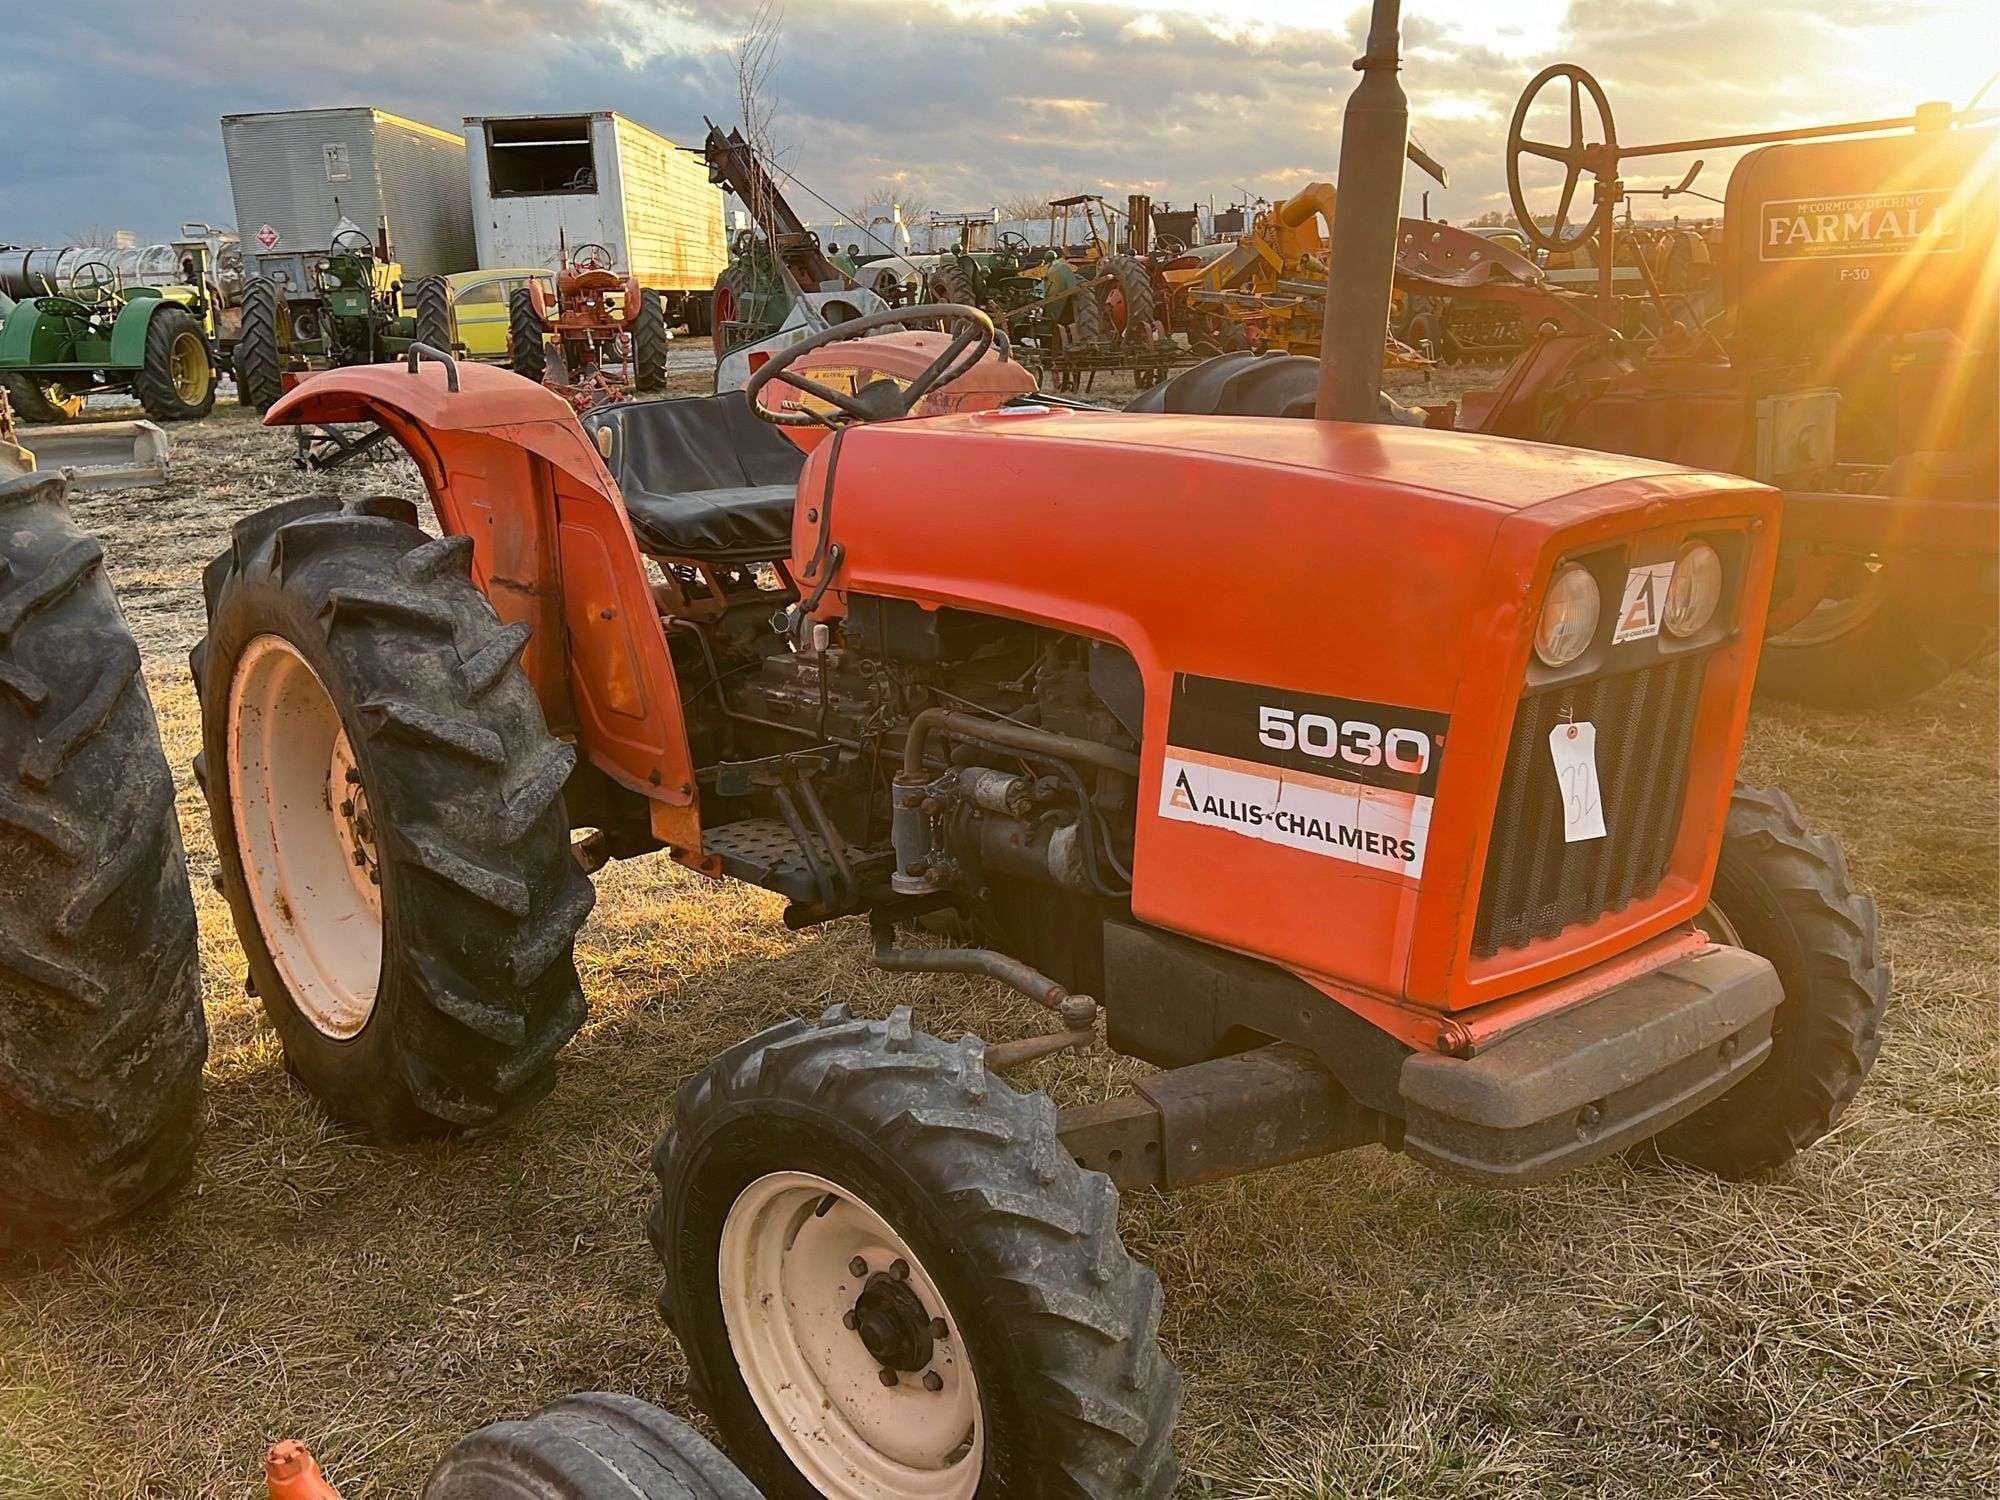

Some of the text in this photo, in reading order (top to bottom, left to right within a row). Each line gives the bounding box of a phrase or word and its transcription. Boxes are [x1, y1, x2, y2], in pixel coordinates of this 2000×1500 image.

[1768, 209, 1951, 245] FARMALL
[1840, 268, 1870, 281] F-30
[1259, 706, 1431, 774] 5030
[1203, 796, 1416, 862] ALLIS-CHALMERS
